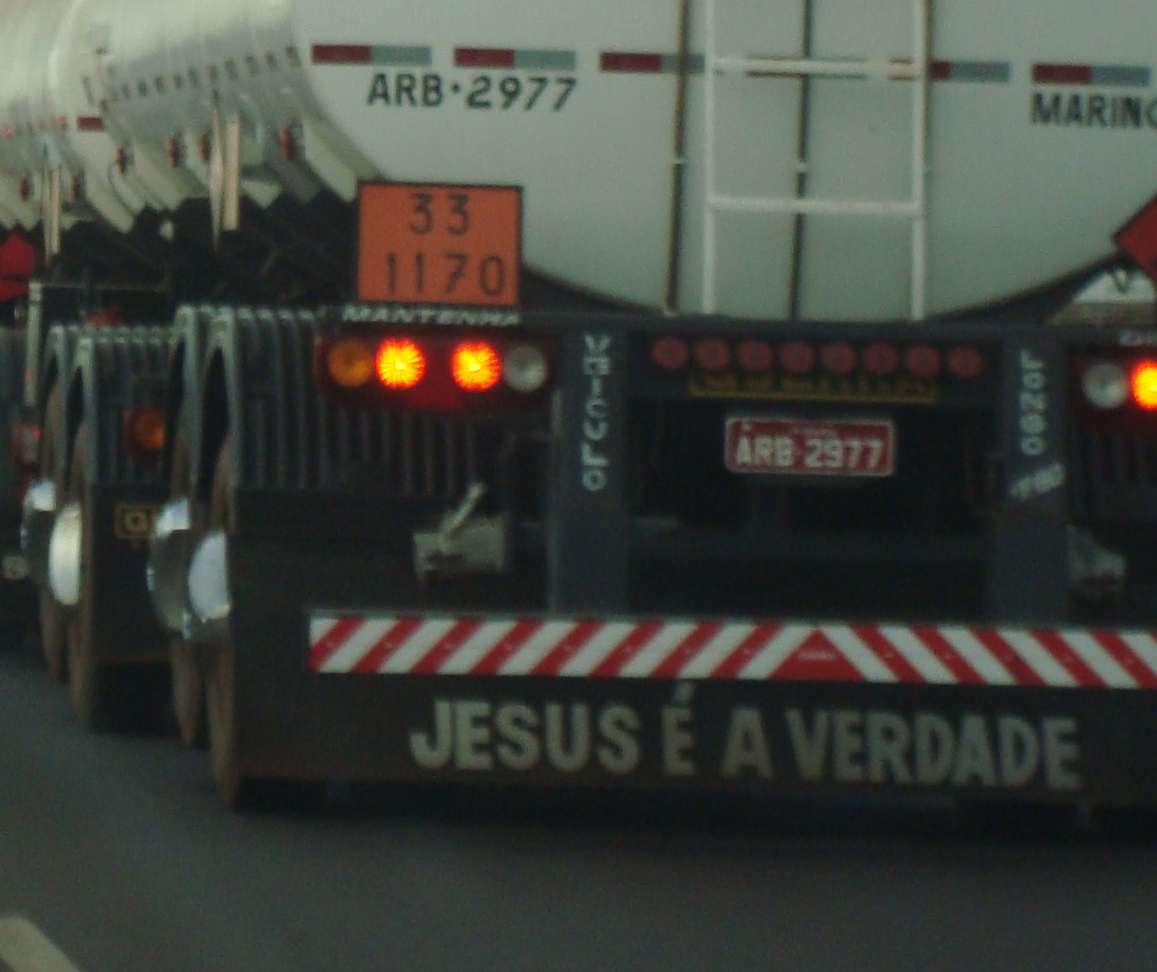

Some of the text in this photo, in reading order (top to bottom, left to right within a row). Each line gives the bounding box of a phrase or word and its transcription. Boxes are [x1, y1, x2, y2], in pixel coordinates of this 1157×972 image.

[408, 192, 472, 236] 33
[385, 252, 508, 296] 1170
[408, 680, 1080, 791] JESUS É A VERDADE
